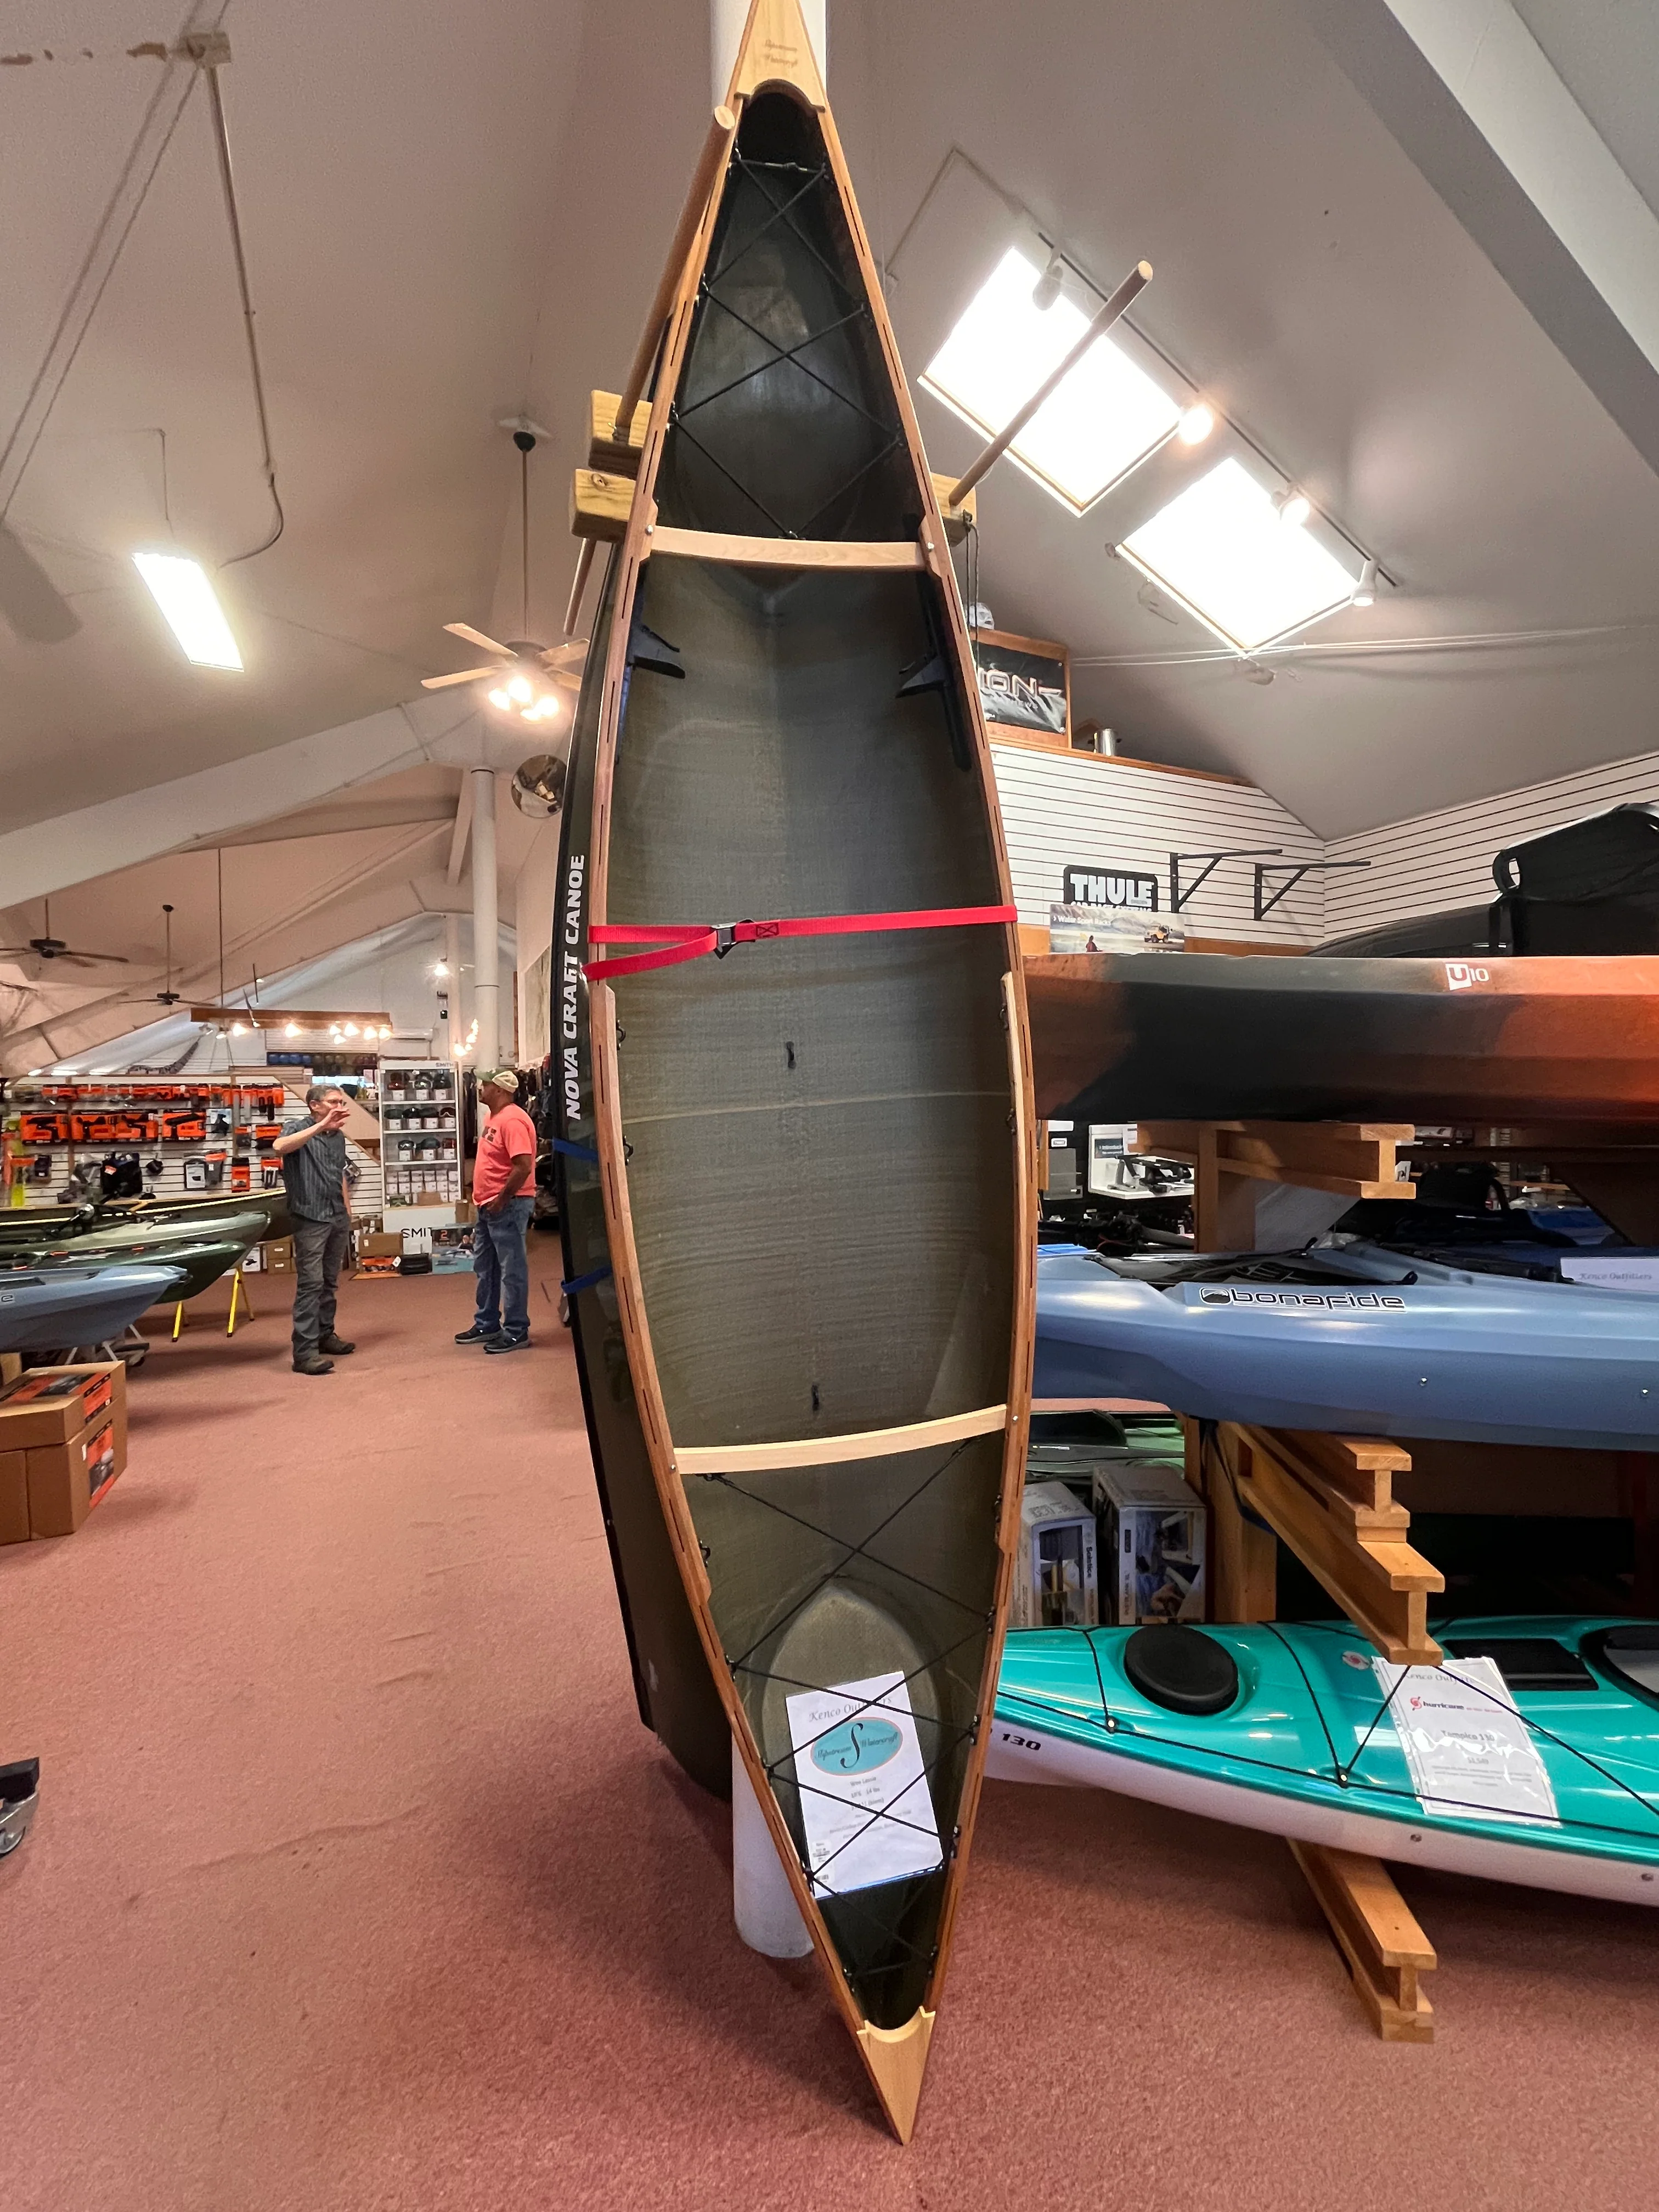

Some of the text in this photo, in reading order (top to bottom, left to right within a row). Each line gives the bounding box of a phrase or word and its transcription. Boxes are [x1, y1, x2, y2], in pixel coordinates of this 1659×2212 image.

[1070, 873, 1154, 907] THULE
[563, 854, 585, 1120] NOVA CRAFT CANOE
[400, 1227, 432, 1239] SMIT
[1231, 1288, 1406, 1311] bonafide
[1423, 1701, 1464, 1710] hurricane
[809, 1708, 841, 1723] Kenco
[1002, 1733, 1041, 1751] 130
